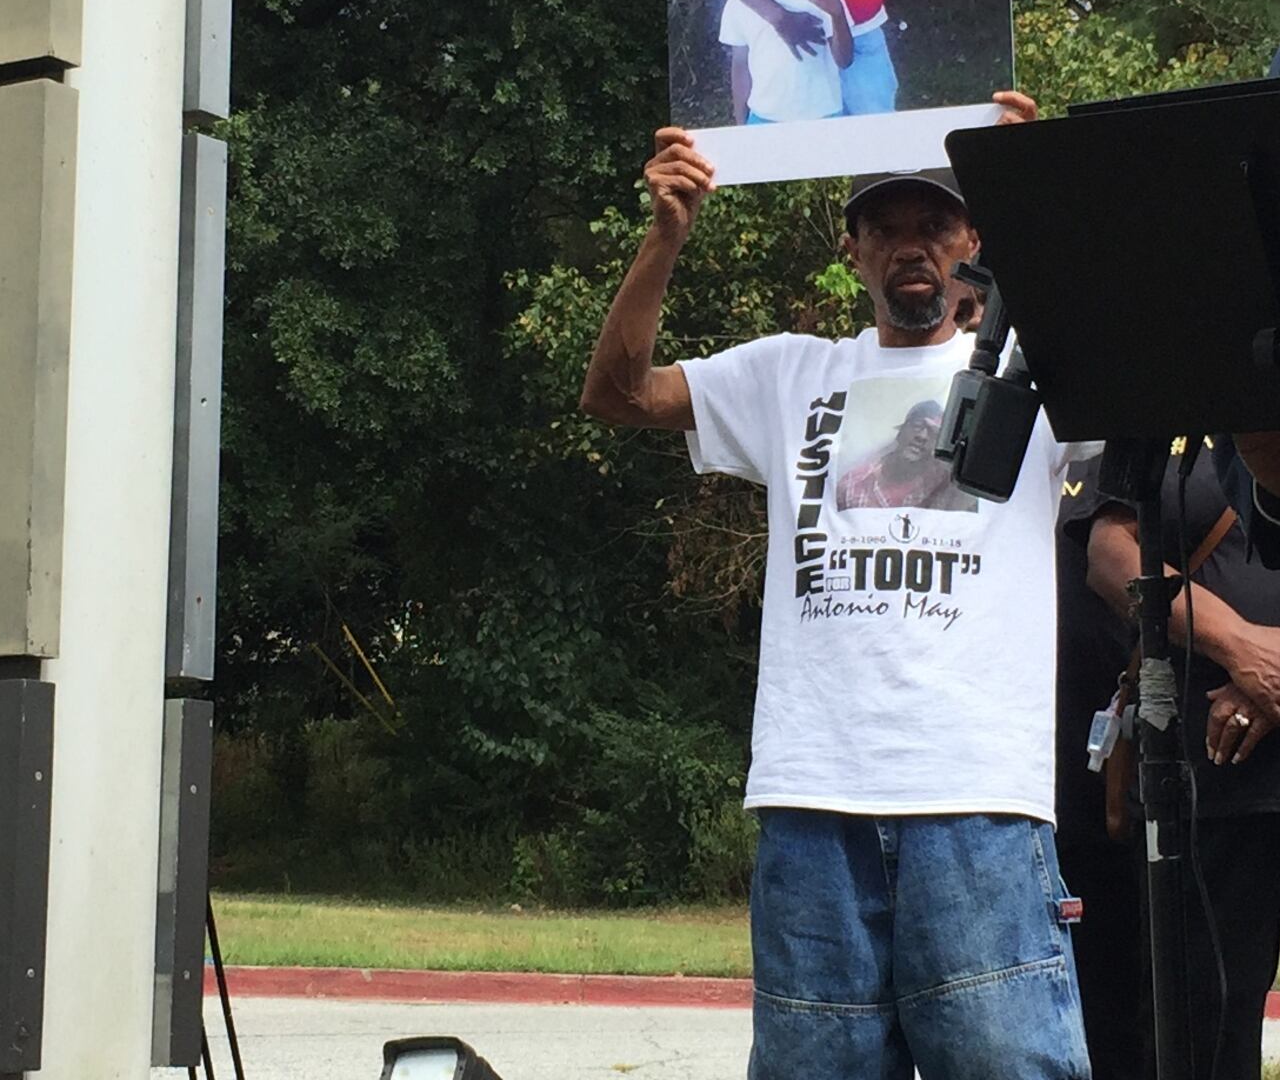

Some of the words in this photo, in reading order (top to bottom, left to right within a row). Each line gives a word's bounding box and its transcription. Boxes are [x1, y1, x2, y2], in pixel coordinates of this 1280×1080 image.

[794, 391, 848, 598] JUSTICE
[825, 575, 851, 592] FOR
[800, 590, 889, 623] Antonio
[903, 587, 963, 630] May
